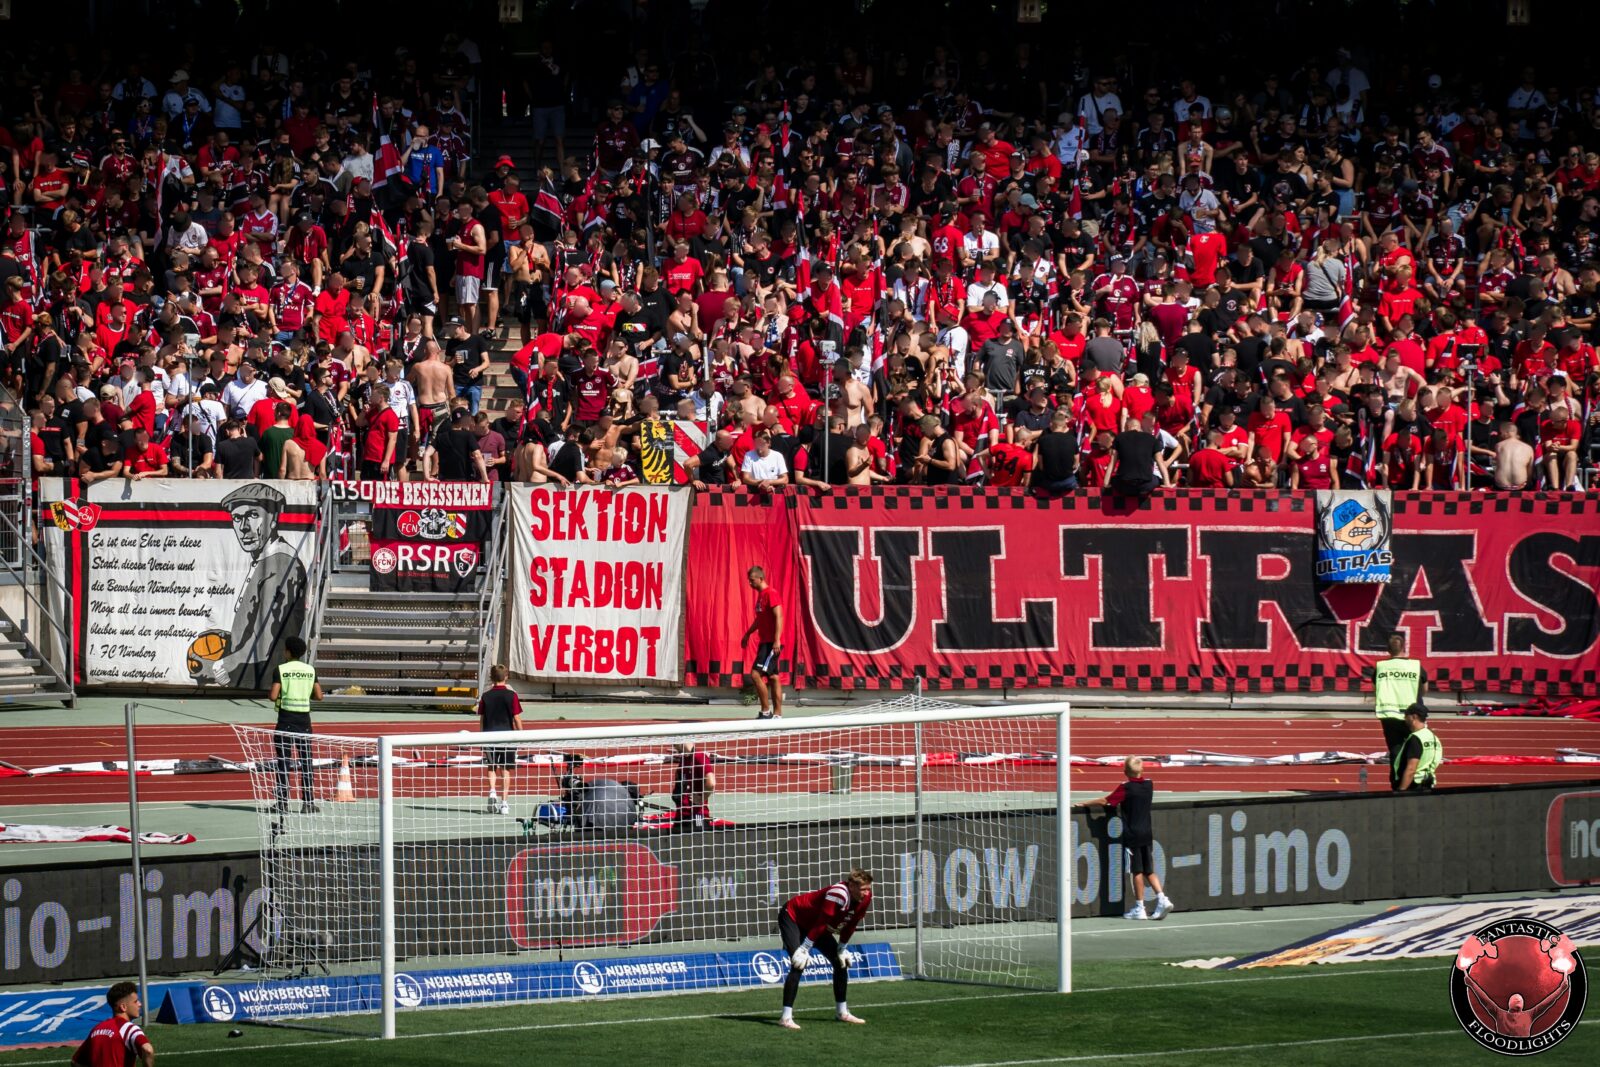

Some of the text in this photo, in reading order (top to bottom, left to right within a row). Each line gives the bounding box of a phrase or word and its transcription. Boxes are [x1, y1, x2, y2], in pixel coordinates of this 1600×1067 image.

[331, 480, 374, 500] 030
[376, 481, 490, 506] DIE BESESSENEN
[530, 488, 669, 544] SEKTION
[401, 522, 418, 533] FCN
[92, 533, 202, 552] Es ist eine Ehre für diese
[121, 558, 147, 570] diesen
[148, 556, 175, 572] Verein
[177, 558, 196, 572] und
[397, 544, 450, 572] RSR
[1316, 550, 1393, 576] ULTRAS
[91, 578, 235, 598] die Bewohner Nürnbergs zu spielen
[530, 556, 664, 610] STADION
[1344, 573, 1392, 584] seit 2002
[799, 523, 1600, 660] ULTRAS
[91, 600, 212, 618] Möge all das immer bewahrt
[90, 622, 117, 635] bleiben
[120, 626, 135, 636] und
[138, 626, 152, 636] der
[90, 644, 157, 662] 1. FC Nürnberg
[530, 624, 661, 677] VERBOT
[90, 667, 170, 681] niemals untergehen!
[1389, 670, 1417, 680] POWER
[696, 875, 736, 900] now
[900, 844, 1039, 914] now
[534, 873, 606, 919] now
[605, 961, 688, 977] NÜRNBERGER
[424, 972, 514, 990] NÜRNBERGER
[610, 974, 668, 987] VERSICHERUNG
[238, 984, 331, 1003] NÜRNBERGER
[430, 988, 493, 1001] VERSICHERUNG
[243, 1000, 309, 1015] VERSICHERUNG
